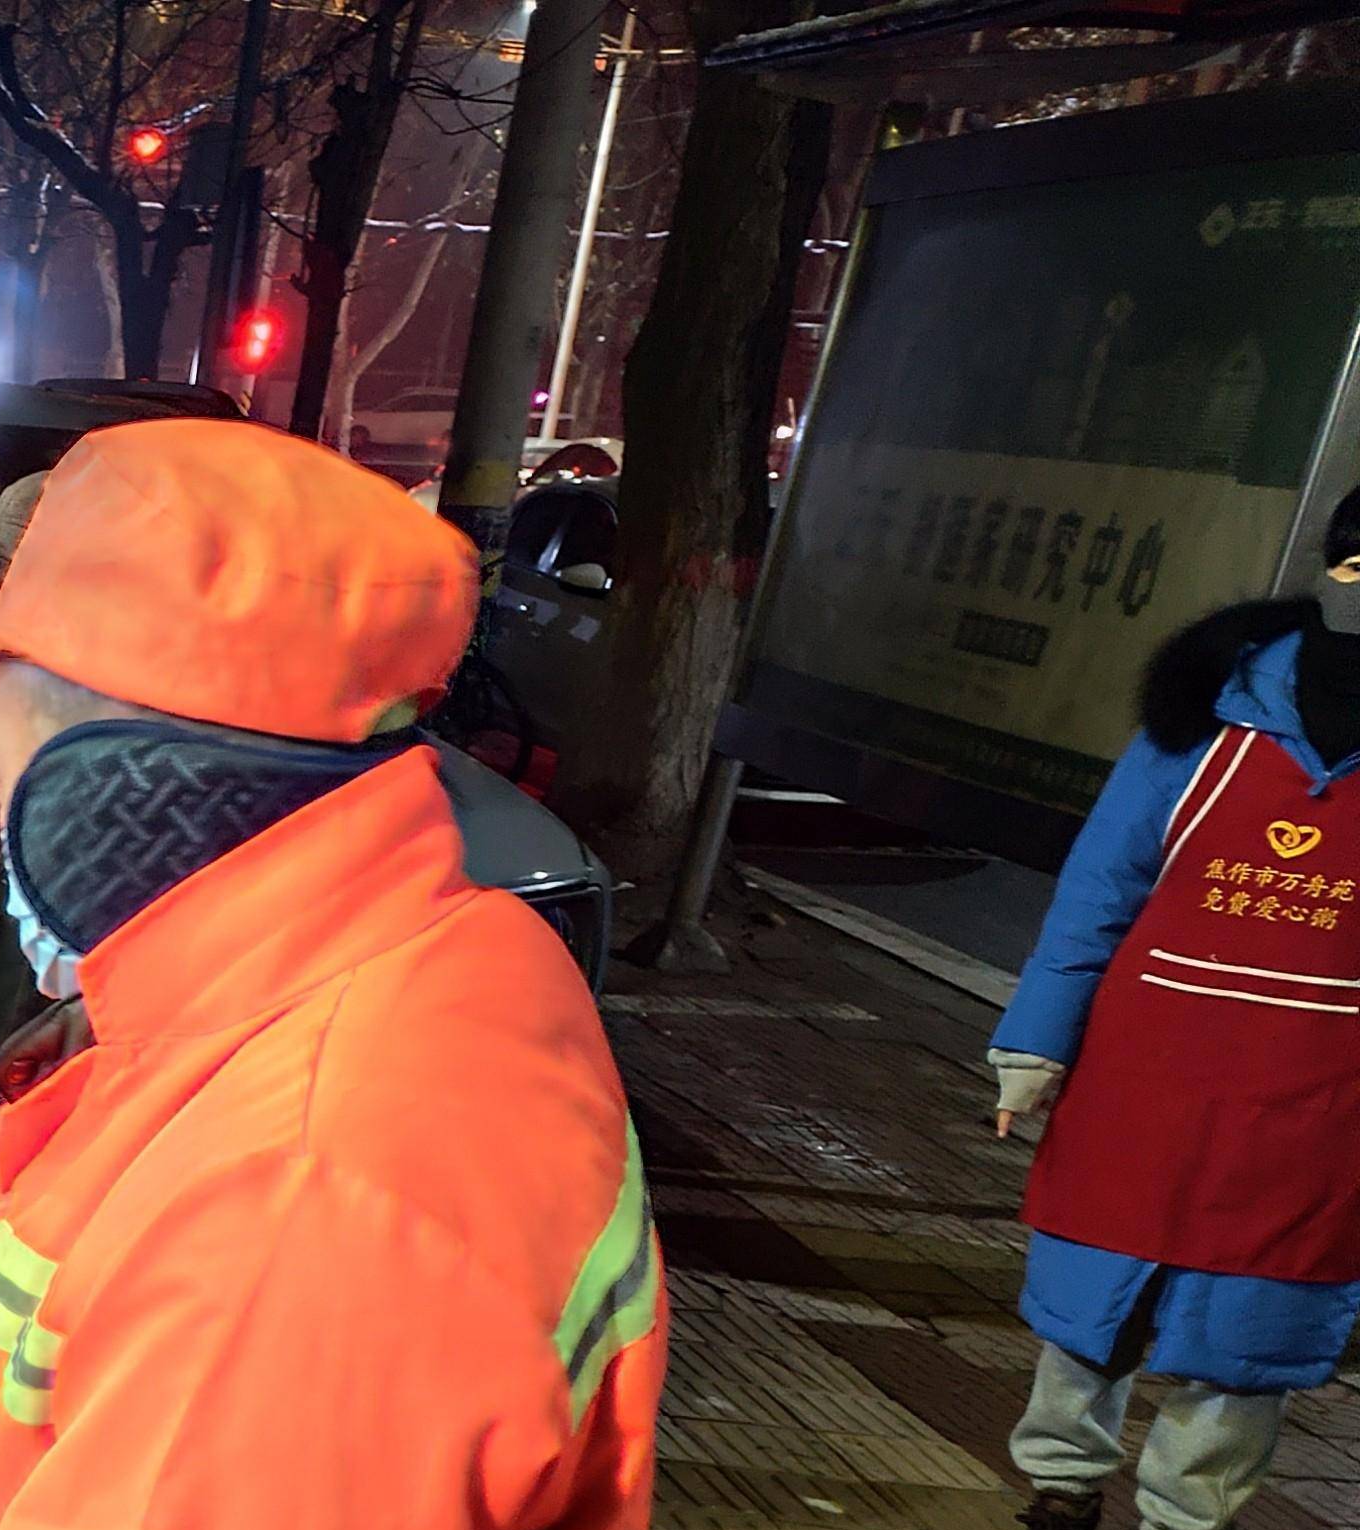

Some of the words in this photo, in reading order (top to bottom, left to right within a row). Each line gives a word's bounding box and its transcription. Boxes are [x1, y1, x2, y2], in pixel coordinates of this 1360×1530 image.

[1201, 858, 1357, 902] 焦作市万舟苑
[1200, 886, 1340, 931] 免费爱心粥
